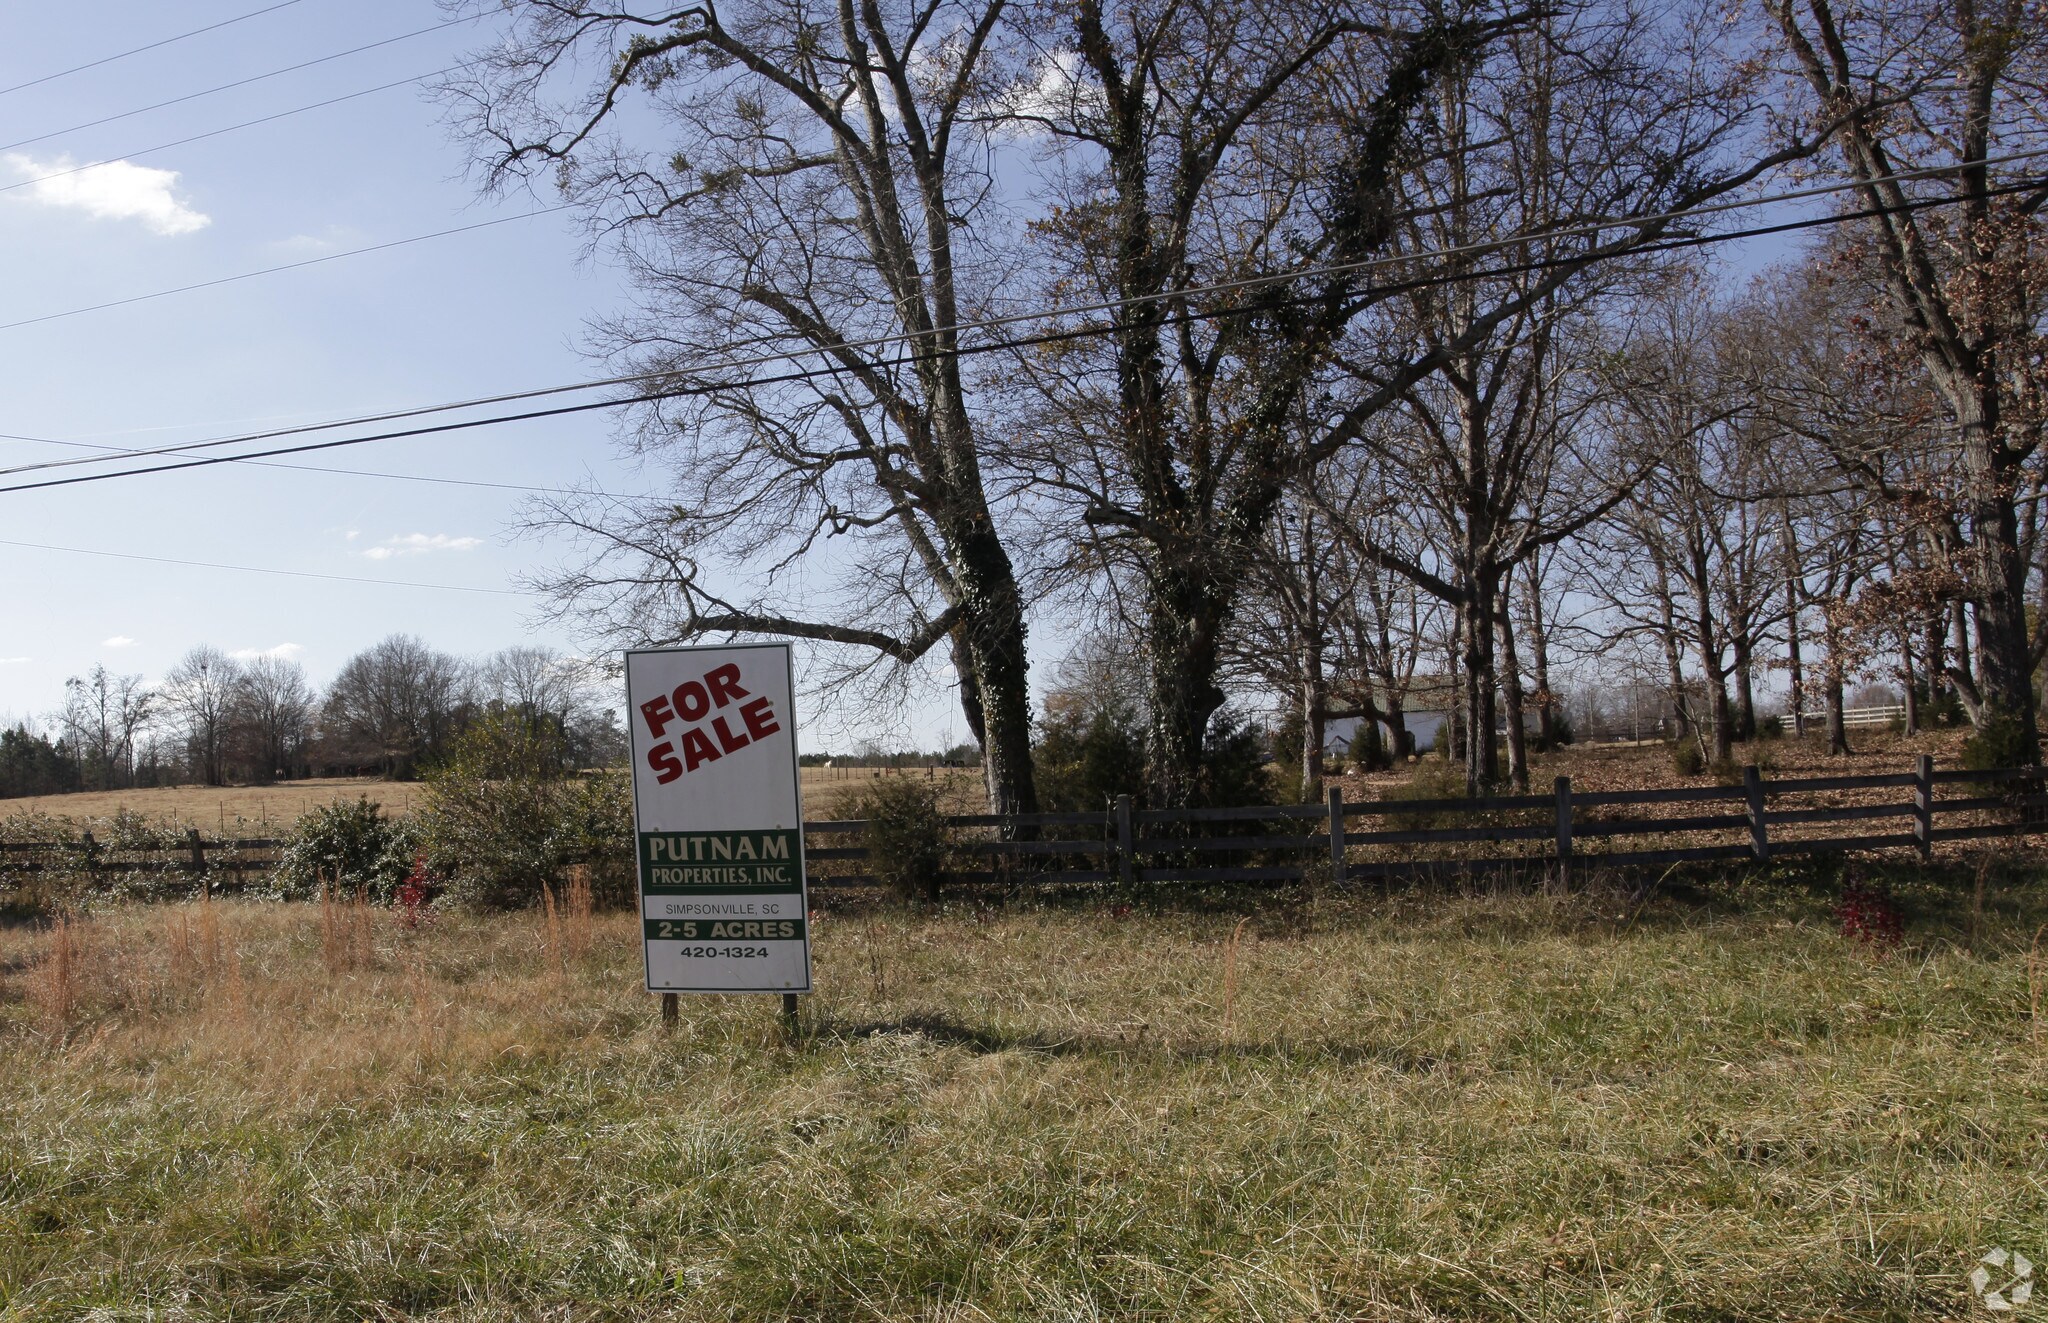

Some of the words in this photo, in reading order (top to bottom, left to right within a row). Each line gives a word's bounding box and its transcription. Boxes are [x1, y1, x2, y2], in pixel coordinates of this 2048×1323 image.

[640, 663, 751, 739] FOR
[647, 696, 781, 785] SALE
[649, 835, 790, 861] PUTNAM
[651, 867, 752, 885] PROPERTIES,
[756, 867, 792, 883] INC.
[665, 904, 758, 916] SIMPSONVILLE,
[762, 904, 780, 915] SC
[658, 921, 698, 938] 2-5
[710, 921, 795, 938] ACRES
[680, 947, 769, 958] 420-1324
